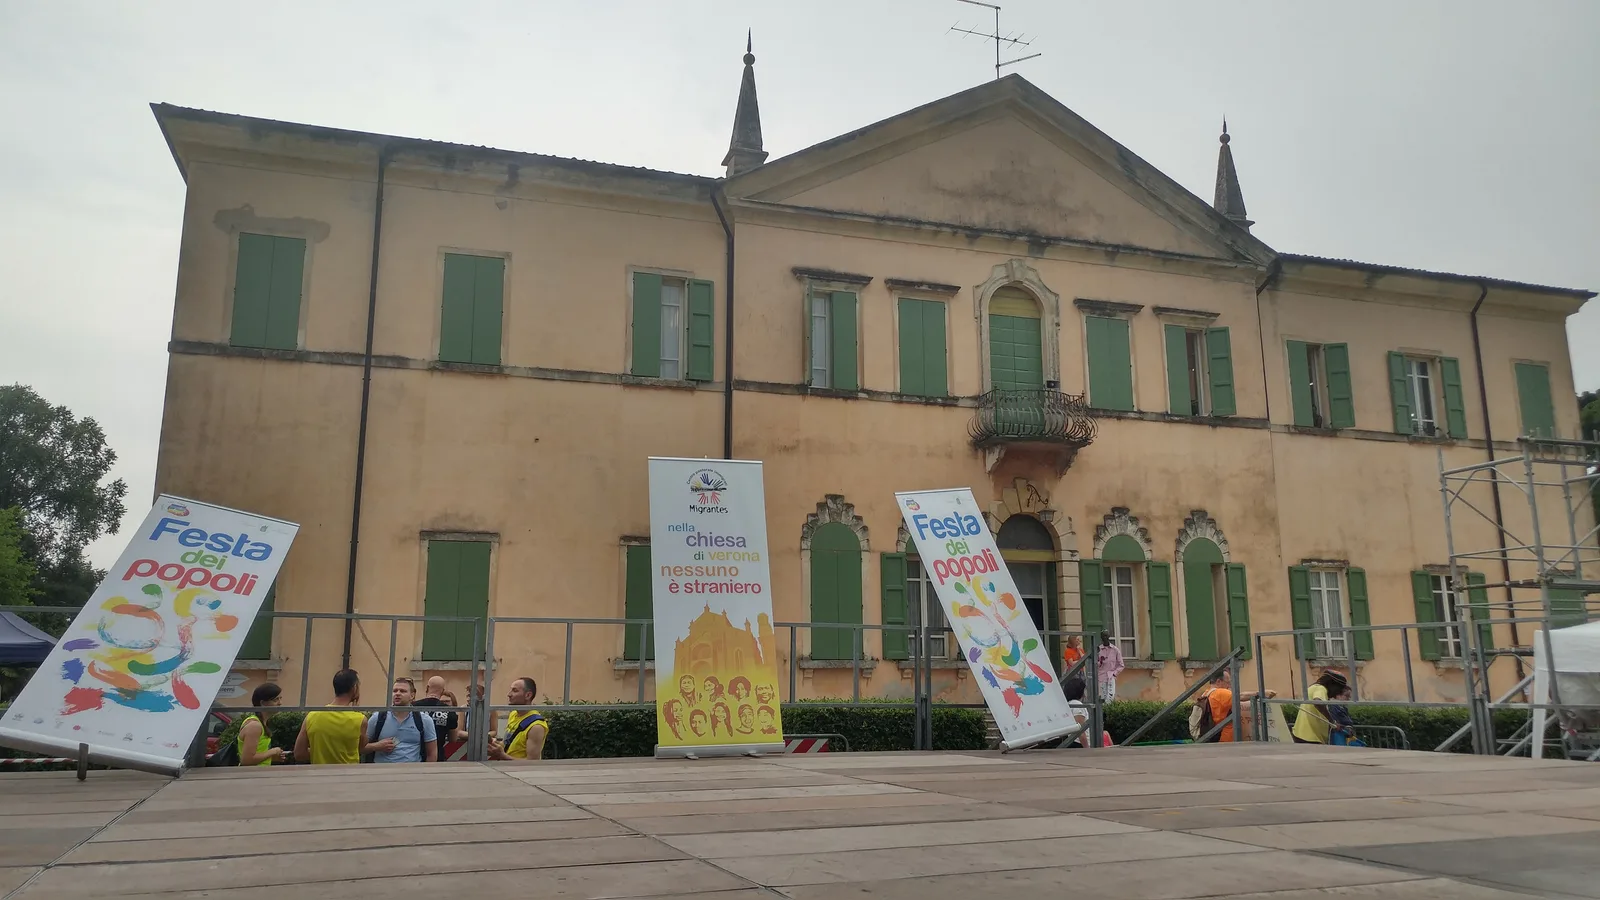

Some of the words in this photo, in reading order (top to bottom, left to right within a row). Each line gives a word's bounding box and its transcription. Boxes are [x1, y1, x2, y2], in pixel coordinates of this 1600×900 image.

[689, 504, 729, 515] Migrantes
[668, 522, 695, 532] nella
[912, 511, 981, 541] Festa
[149, 517, 273, 562] Festa
[685, 531, 747, 548] chiesa
[945, 538, 971, 556] dei
[180, 550, 228, 571] dei
[693, 551, 704, 561] di
[708, 551, 760, 562] verona
[661, 565, 739, 577] nessuno
[933, 548, 1000, 586] popoli
[122, 558, 259, 597] popoli
[668, 579, 679, 594] è
[684, 579, 762, 594] straniero
